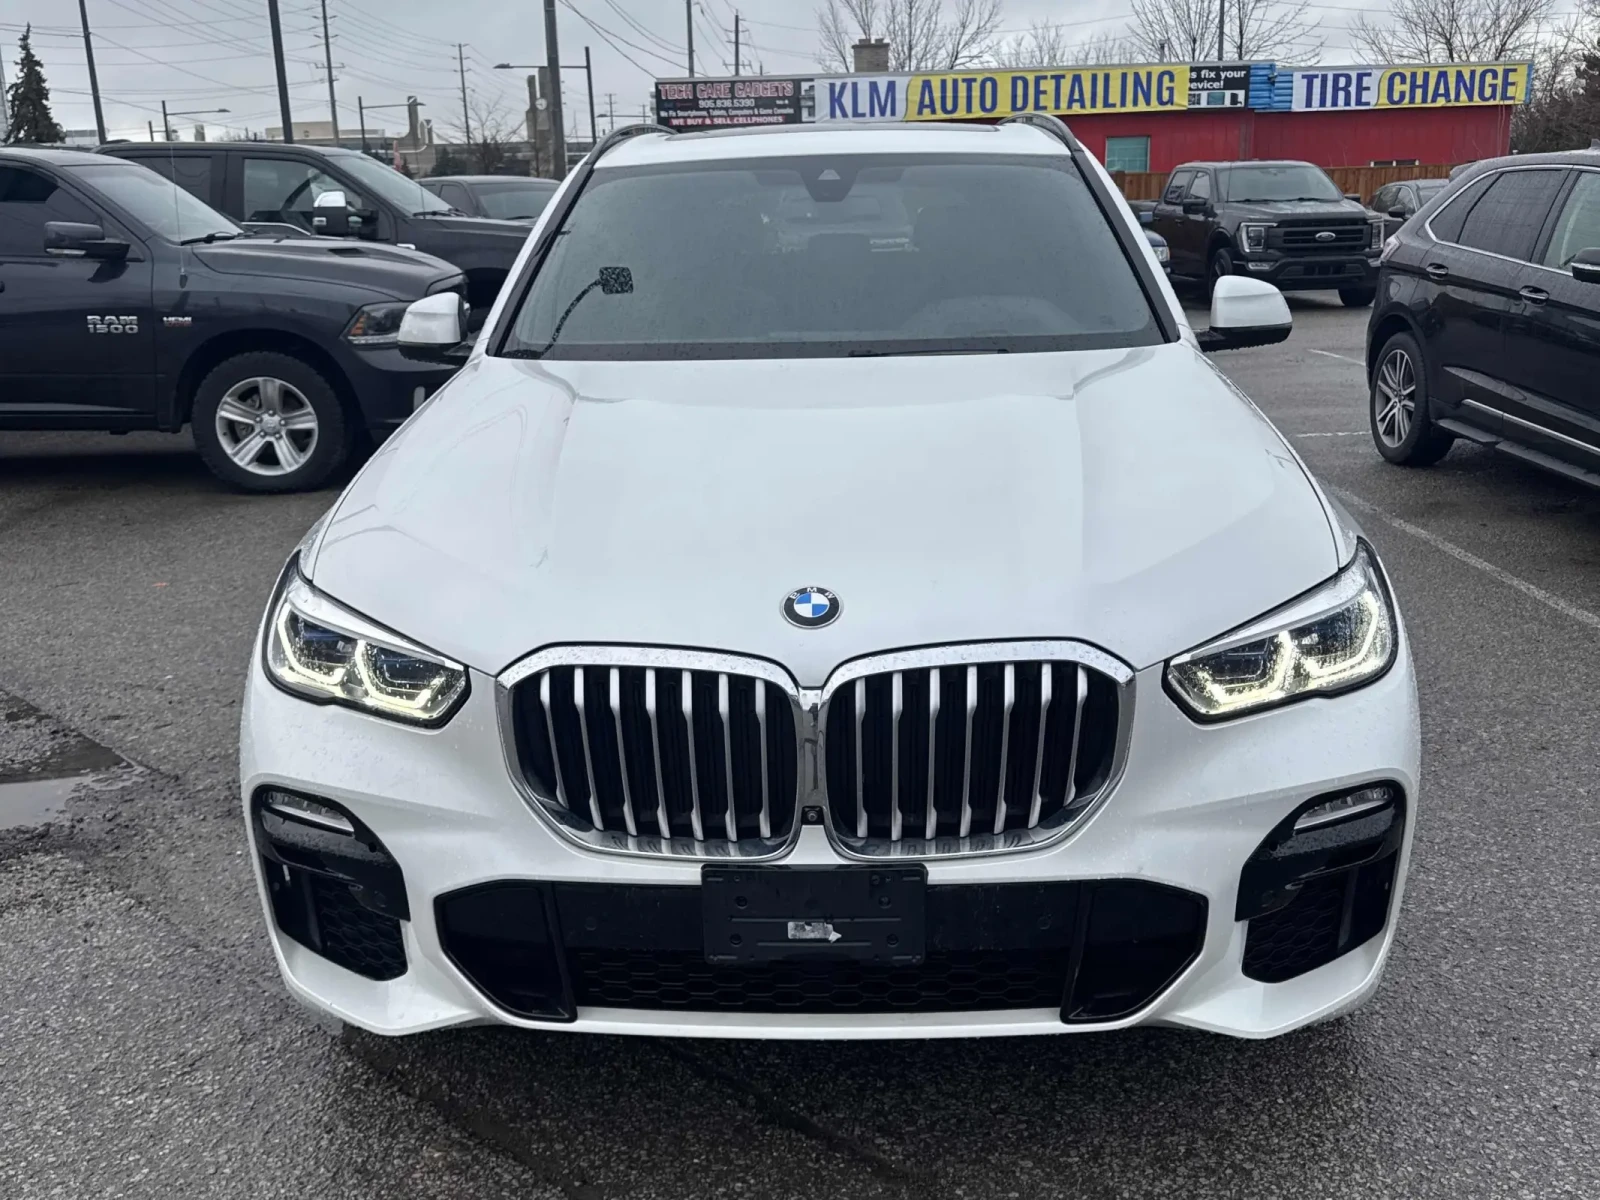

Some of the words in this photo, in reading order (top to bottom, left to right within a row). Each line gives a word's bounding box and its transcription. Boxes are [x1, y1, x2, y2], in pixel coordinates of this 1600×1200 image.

[1200, 69, 1216, 79] fix
[1219, 70, 1247, 80] your
[659, 84, 693, 99] TECH
[696, 82, 731, 98] CARE
[734, 81, 794, 97] GADGETS
[1189, 80, 1224, 90] evice!
[1301, 72, 1372, 109] TIRE
[1386, 68, 1518, 106] CHANGE
[829, 80, 896, 119] KLM
[917, 77, 998, 116] AUTO
[1011, 70, 1175, 112] DETAILING
[671, 118, 684, 126] WE
[686, 117, 702, 125] BUY
[704, 117, 712, 125] &
[713, 116, 731, 125] SELL
[732, 115, 784, 124] CELLPHONES
[87, 315, 138, 325] RAM
[87, 325, 138, 334] 1500
[789, 587, 836, 600] BMW
